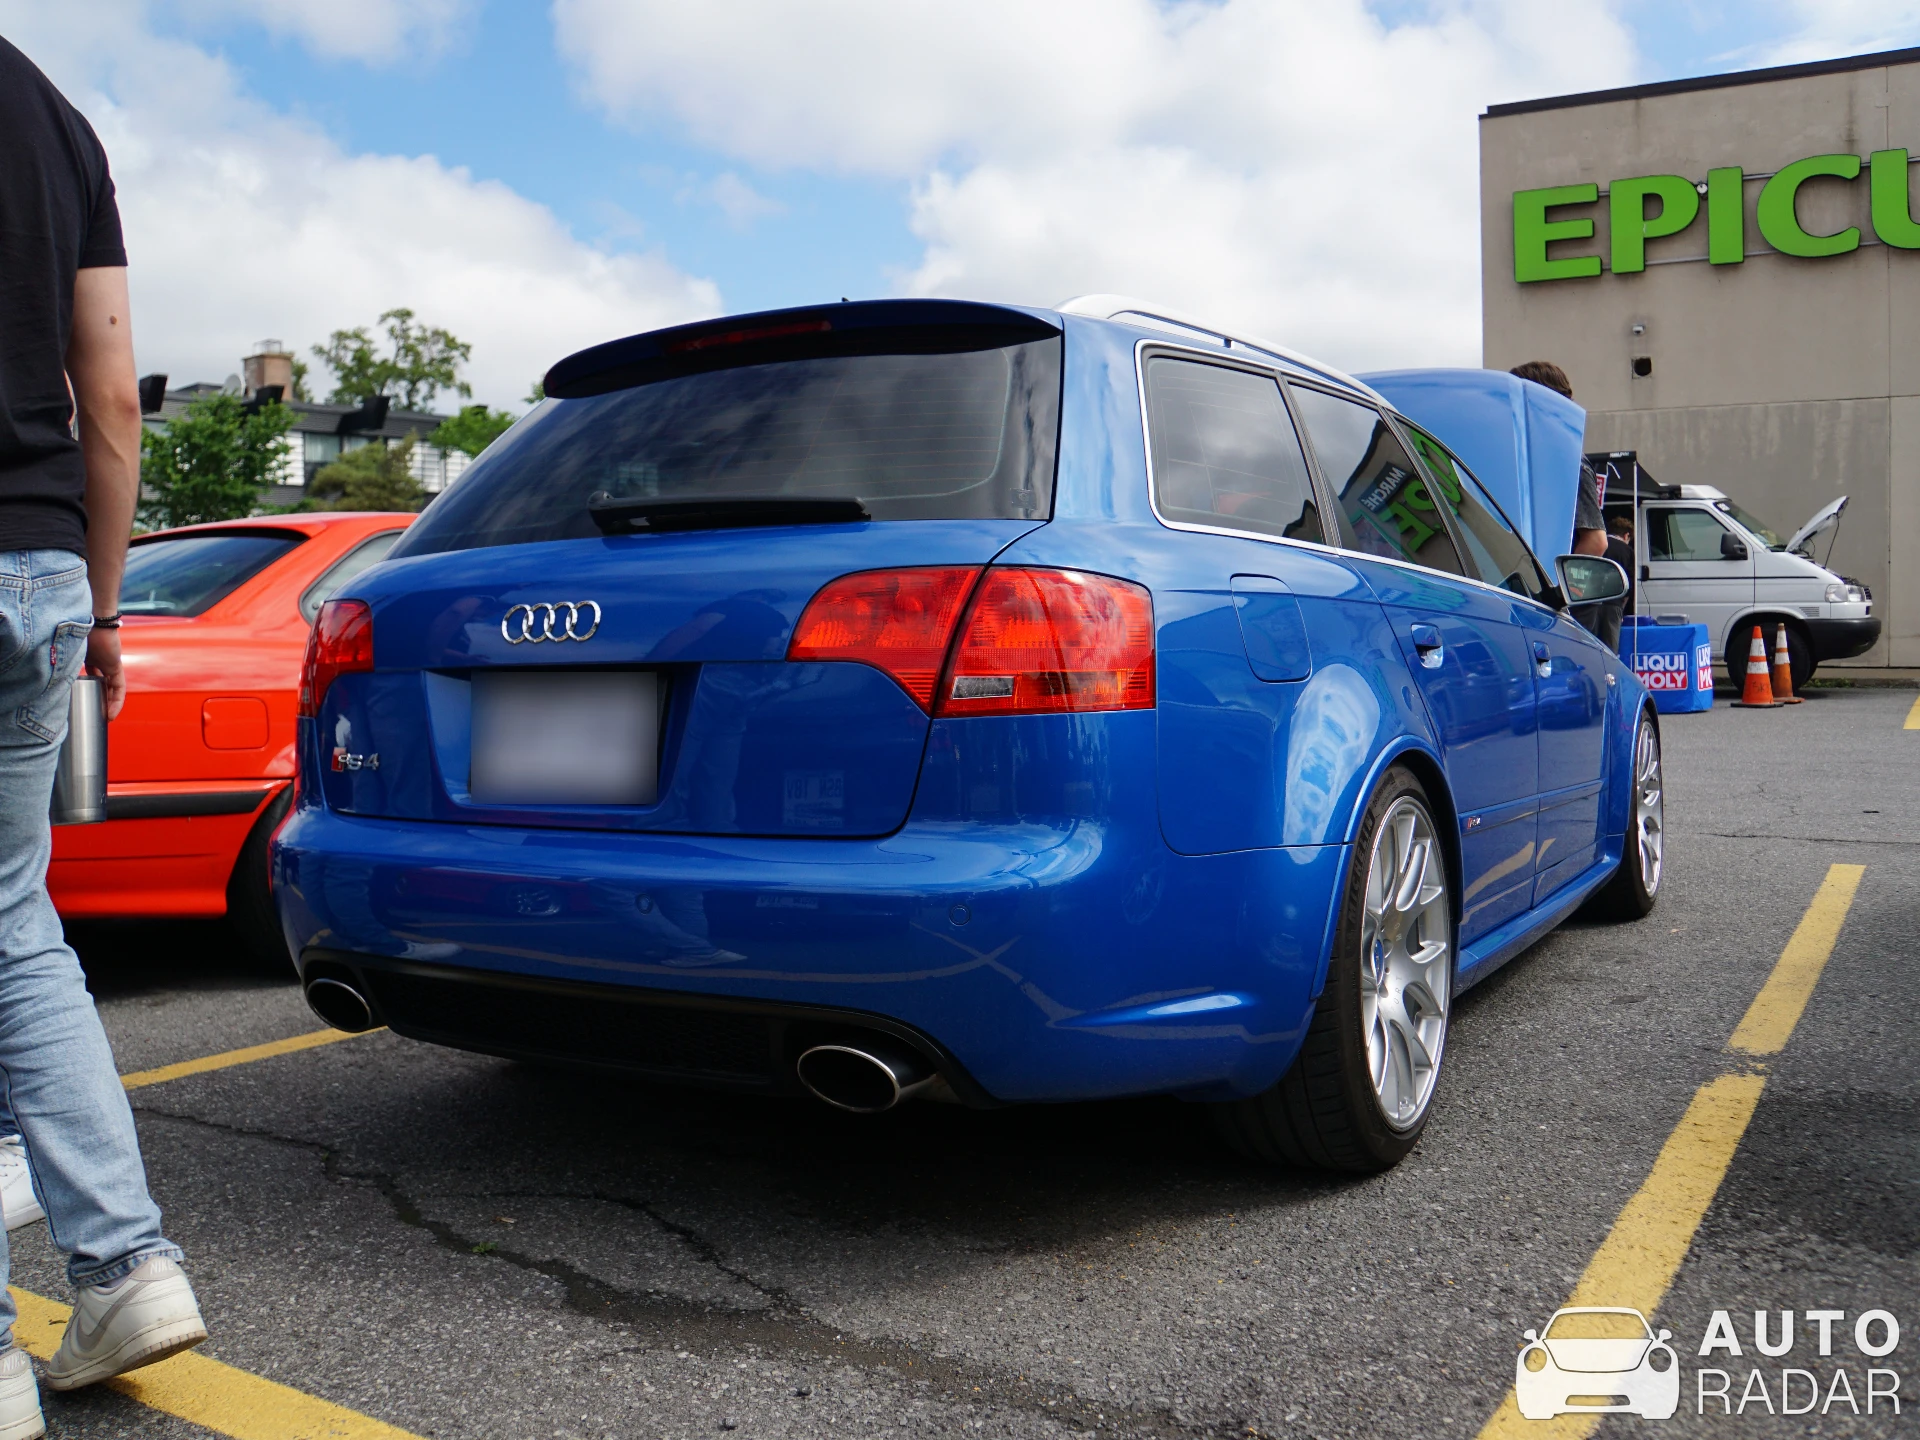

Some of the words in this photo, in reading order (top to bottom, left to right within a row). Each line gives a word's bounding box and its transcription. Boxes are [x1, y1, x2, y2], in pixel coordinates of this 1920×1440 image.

[1636, 654, 1685, 671] LIQUI
[1637, 672, 1686, 688] MOLY
[150, 1259, 174, 1274] NIKE
